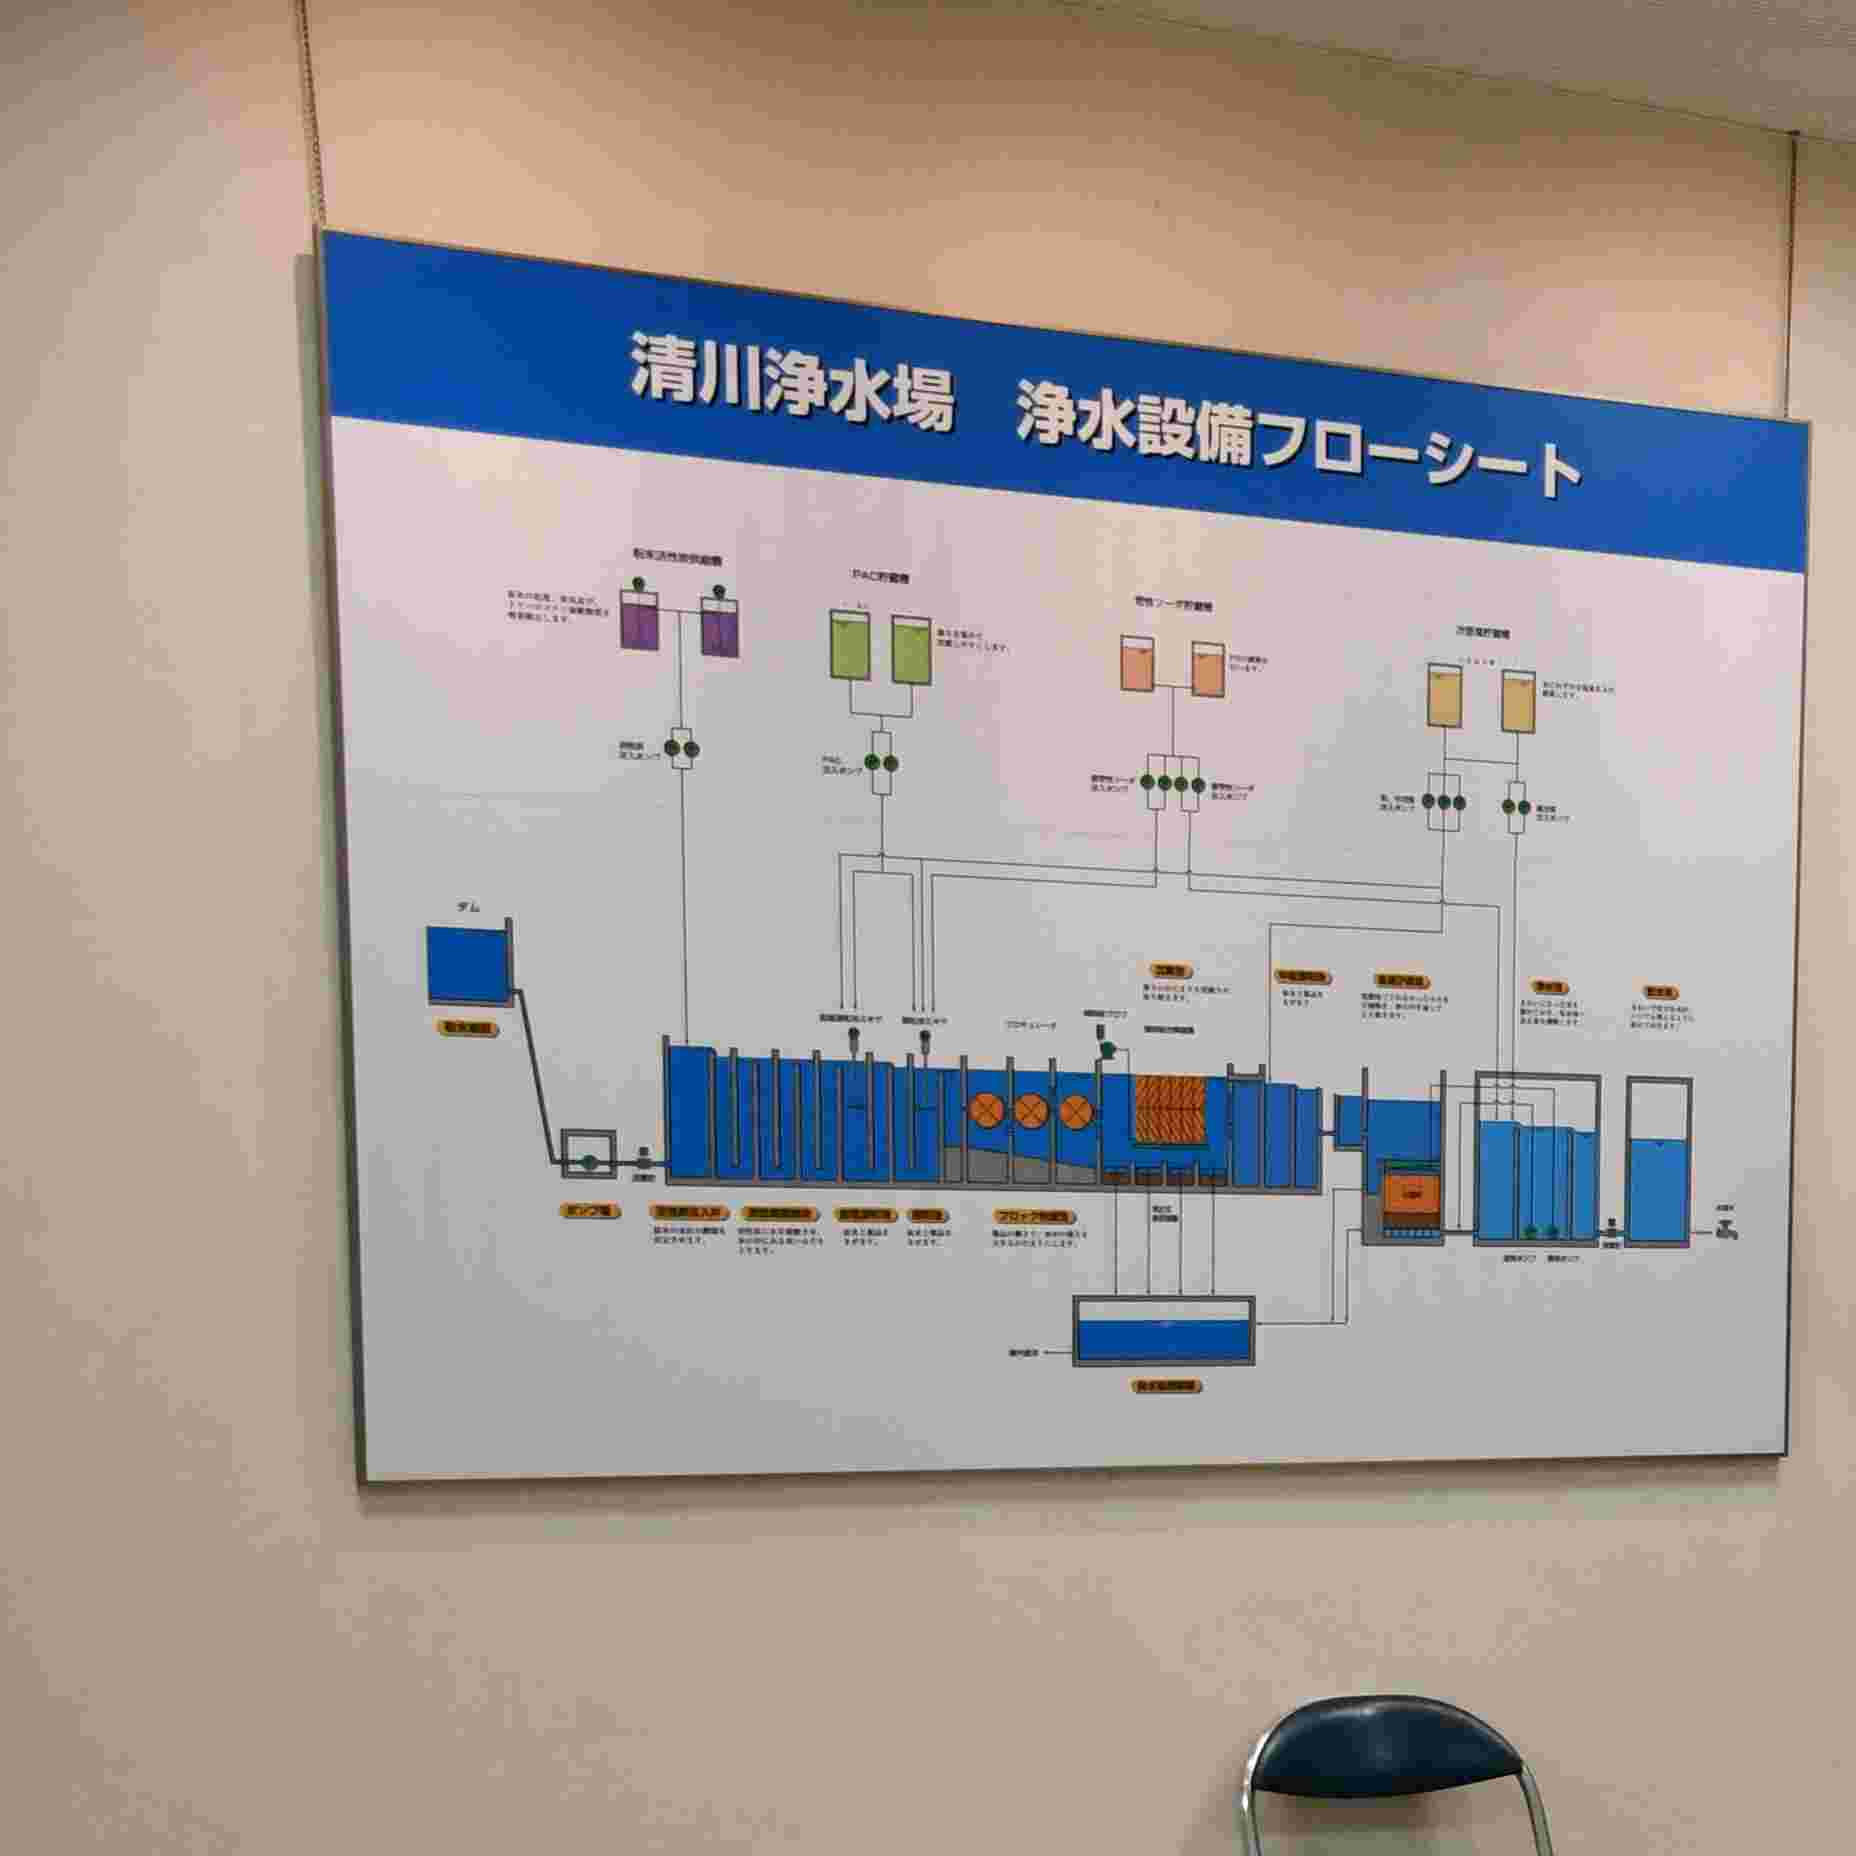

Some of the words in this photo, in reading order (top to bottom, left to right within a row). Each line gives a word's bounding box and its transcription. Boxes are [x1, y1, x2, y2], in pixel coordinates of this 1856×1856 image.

[629, 329, 955, 432] 清川浄水場
[1016, 377, 1583, 498] 浄水設備フローシート
